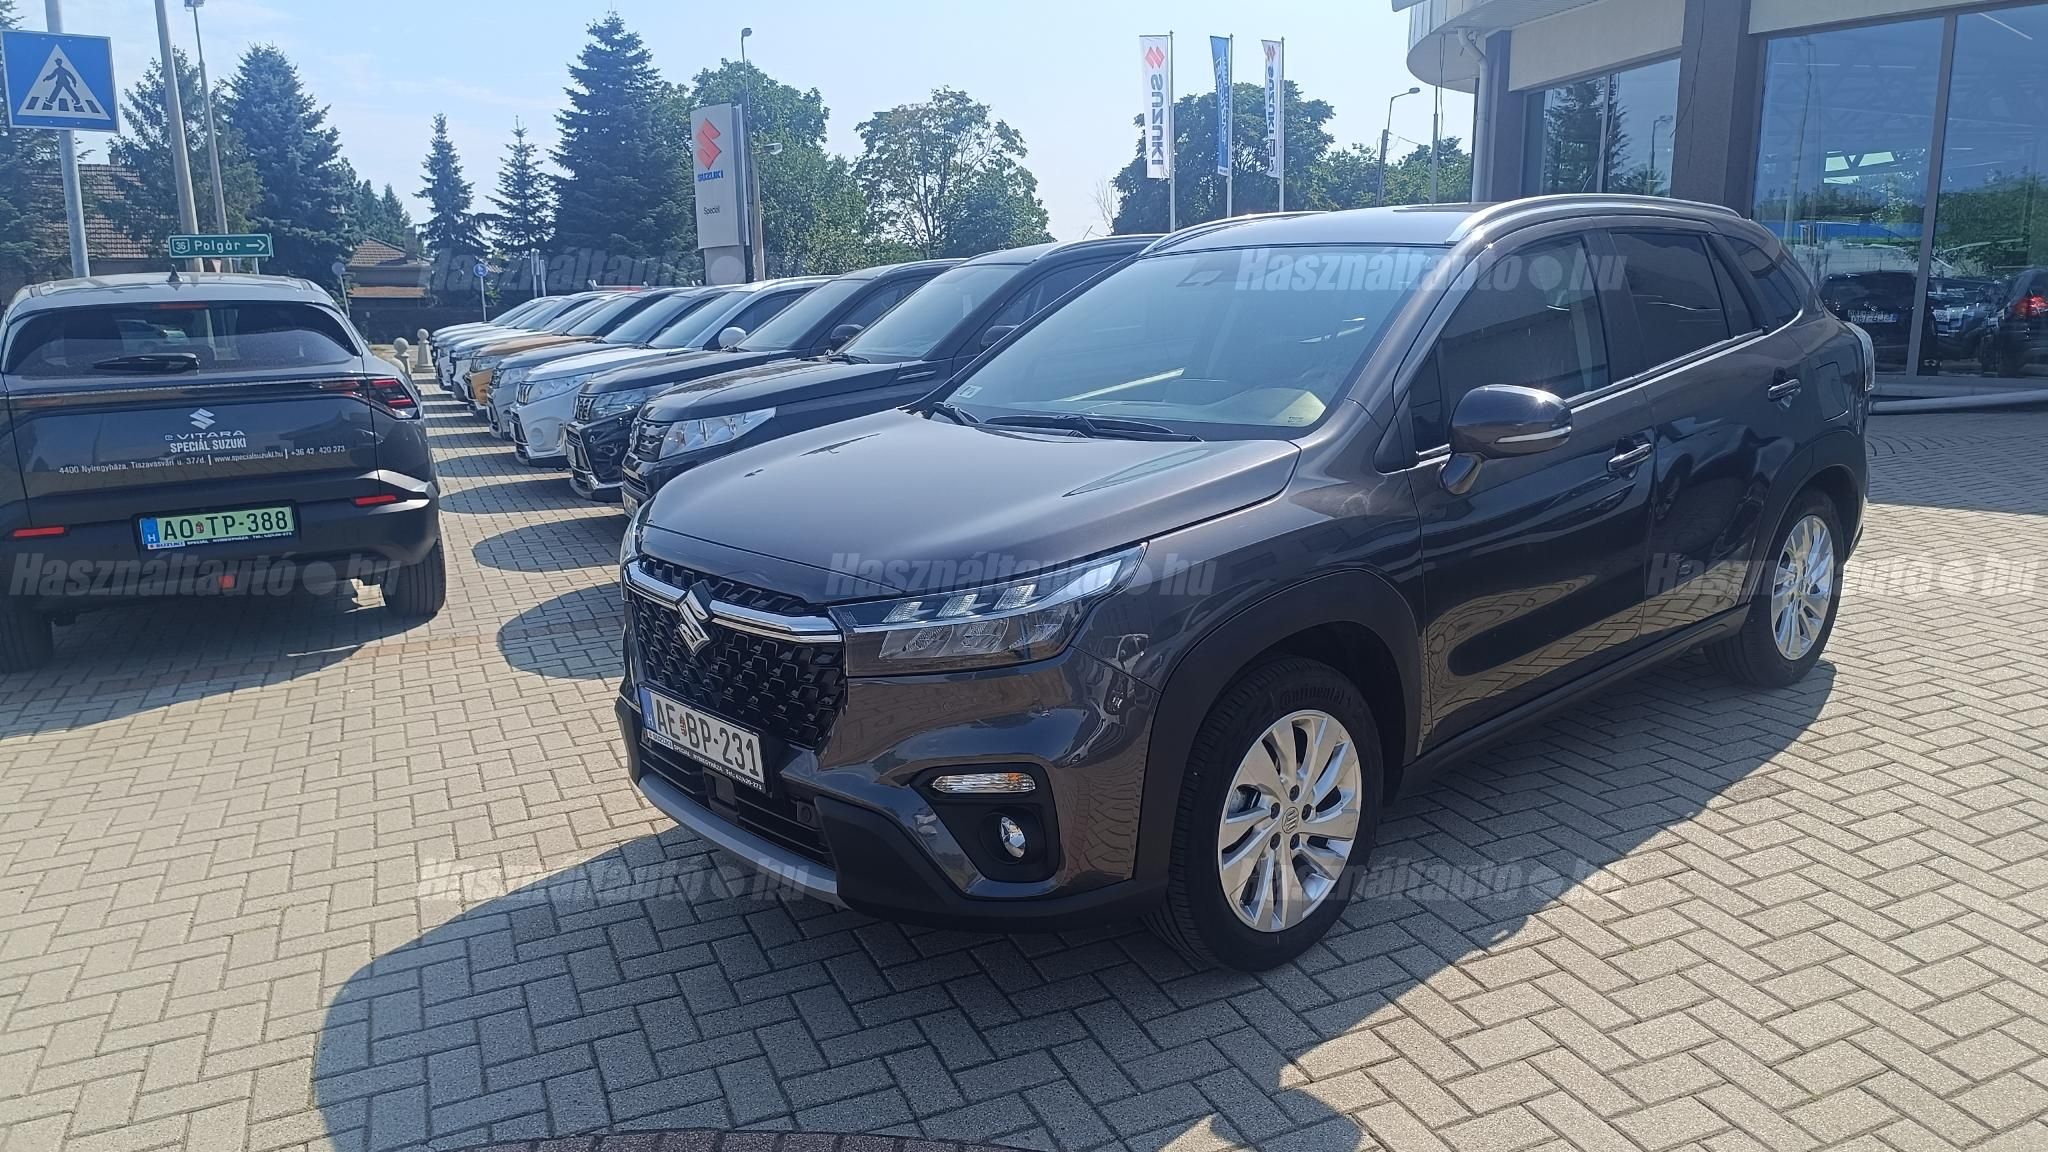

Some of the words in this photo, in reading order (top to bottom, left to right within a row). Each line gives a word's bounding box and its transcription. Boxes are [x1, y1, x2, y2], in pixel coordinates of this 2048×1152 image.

[697, 169, 724, 181] SUZUKI
[175, 241, 186, 250] 36
[194, 240, 241, 253] Polgár
[176, 430, 246, 440] VITARA
[170, 439, 211, 453] SPECIÁL
[212, 438, 247, 450] SUZUKI
[59, 466, 80, 474] 4400
[291, 448, 305, 456] +36
[306, 447, 315, 455] 42
[319, 446, 332, 454] 420
[333, 445, 346, 453] 273
[147, 533, 157, 542] H
